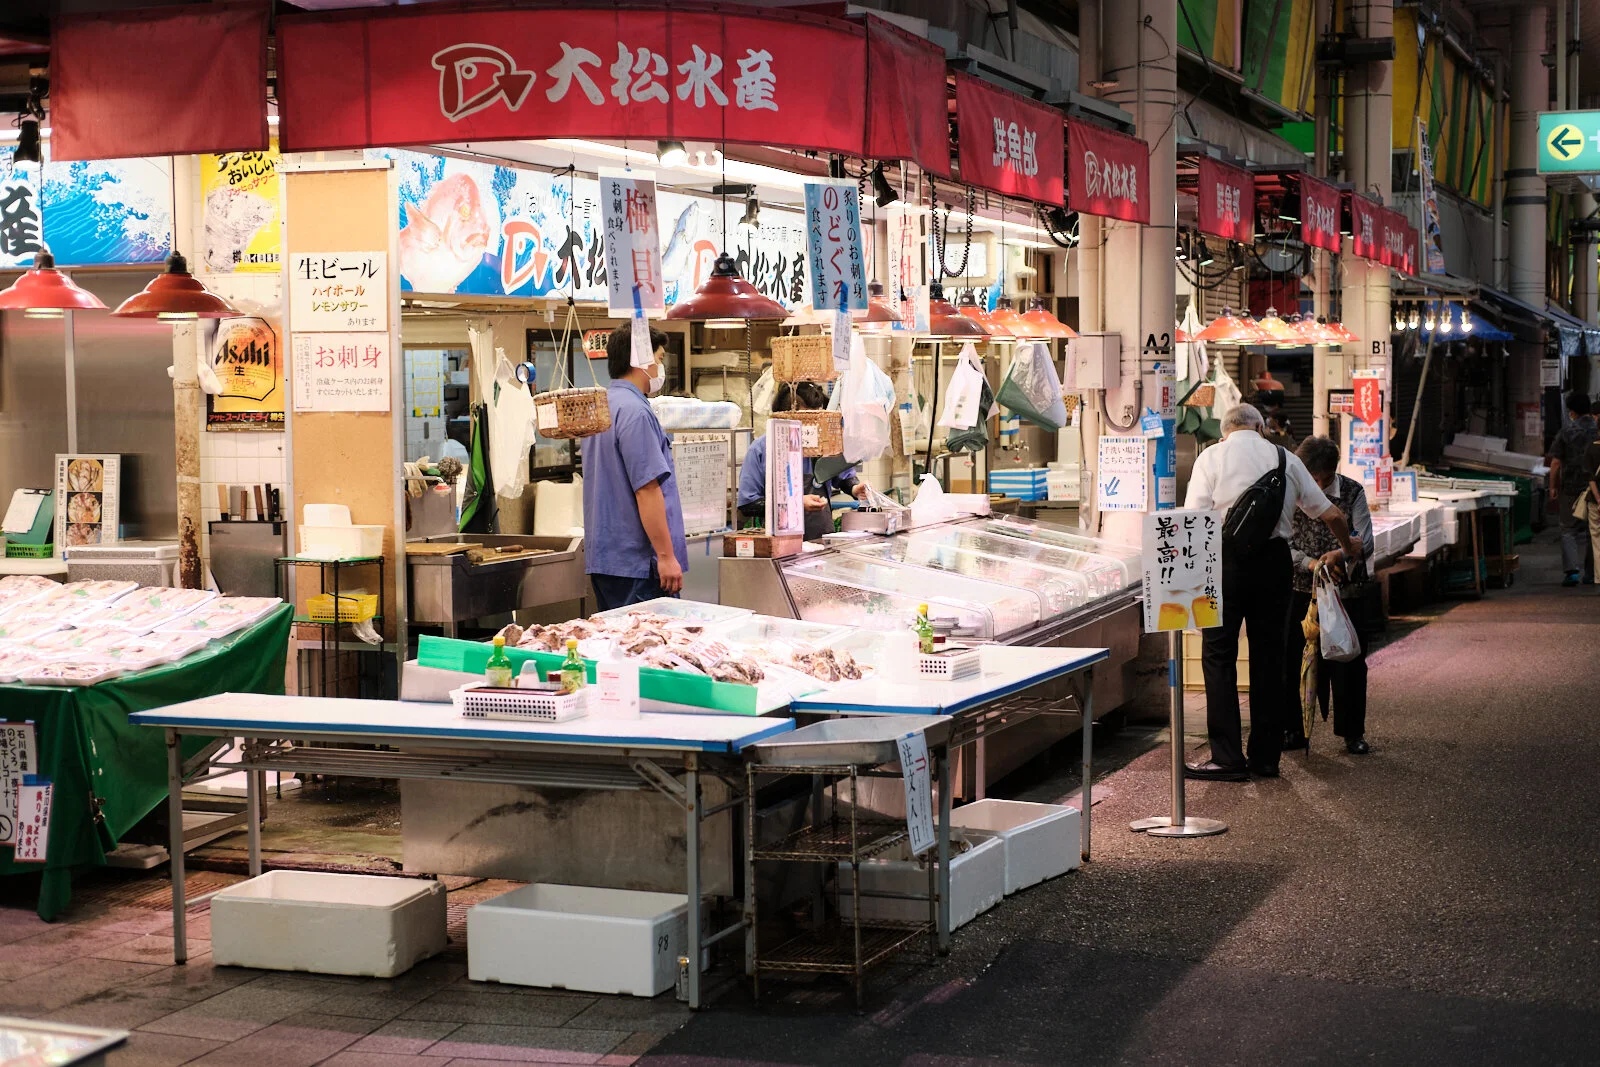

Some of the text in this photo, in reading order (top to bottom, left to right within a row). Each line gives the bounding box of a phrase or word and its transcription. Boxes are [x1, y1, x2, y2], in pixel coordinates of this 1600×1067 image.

[546, 41, 779, 112] 大松水産
[993, 117, 1038, 178] 鮮魚部
[228, 160, 275, 185] おいしい
[1103, 158, 1138, 203] 大松水産
[612, 182, 623, 232] お刺身
[1216, 183, 1241, 224] 鮮魚部
[607, 216, 621, 294] 食べられます
[625, 188, 656, 294] 梅貝
[812, 207, 828, 305] 食べられます
[844, 190, 863, 300] 炙りのお刺身
[298, 257, 380, 280] 生ビール
[312, 285, 366, 297] ハイボール
[312, 301, 369, 313] レモンサワー
[347, 317, 377, 327] あります
[215, 339, 270, 367] Asahi
[315, 344, 382, 369] お刺身
[1143, 333, 1171, 355] A2
[1372, 341, 1386, 354] B1
[234, 366, 245, 376] 生
[1104, 456, 1141, 464] こちらです
[1183, 516, 1197, 570] ビールは
[17, 729, 28, 772] 石川県産
